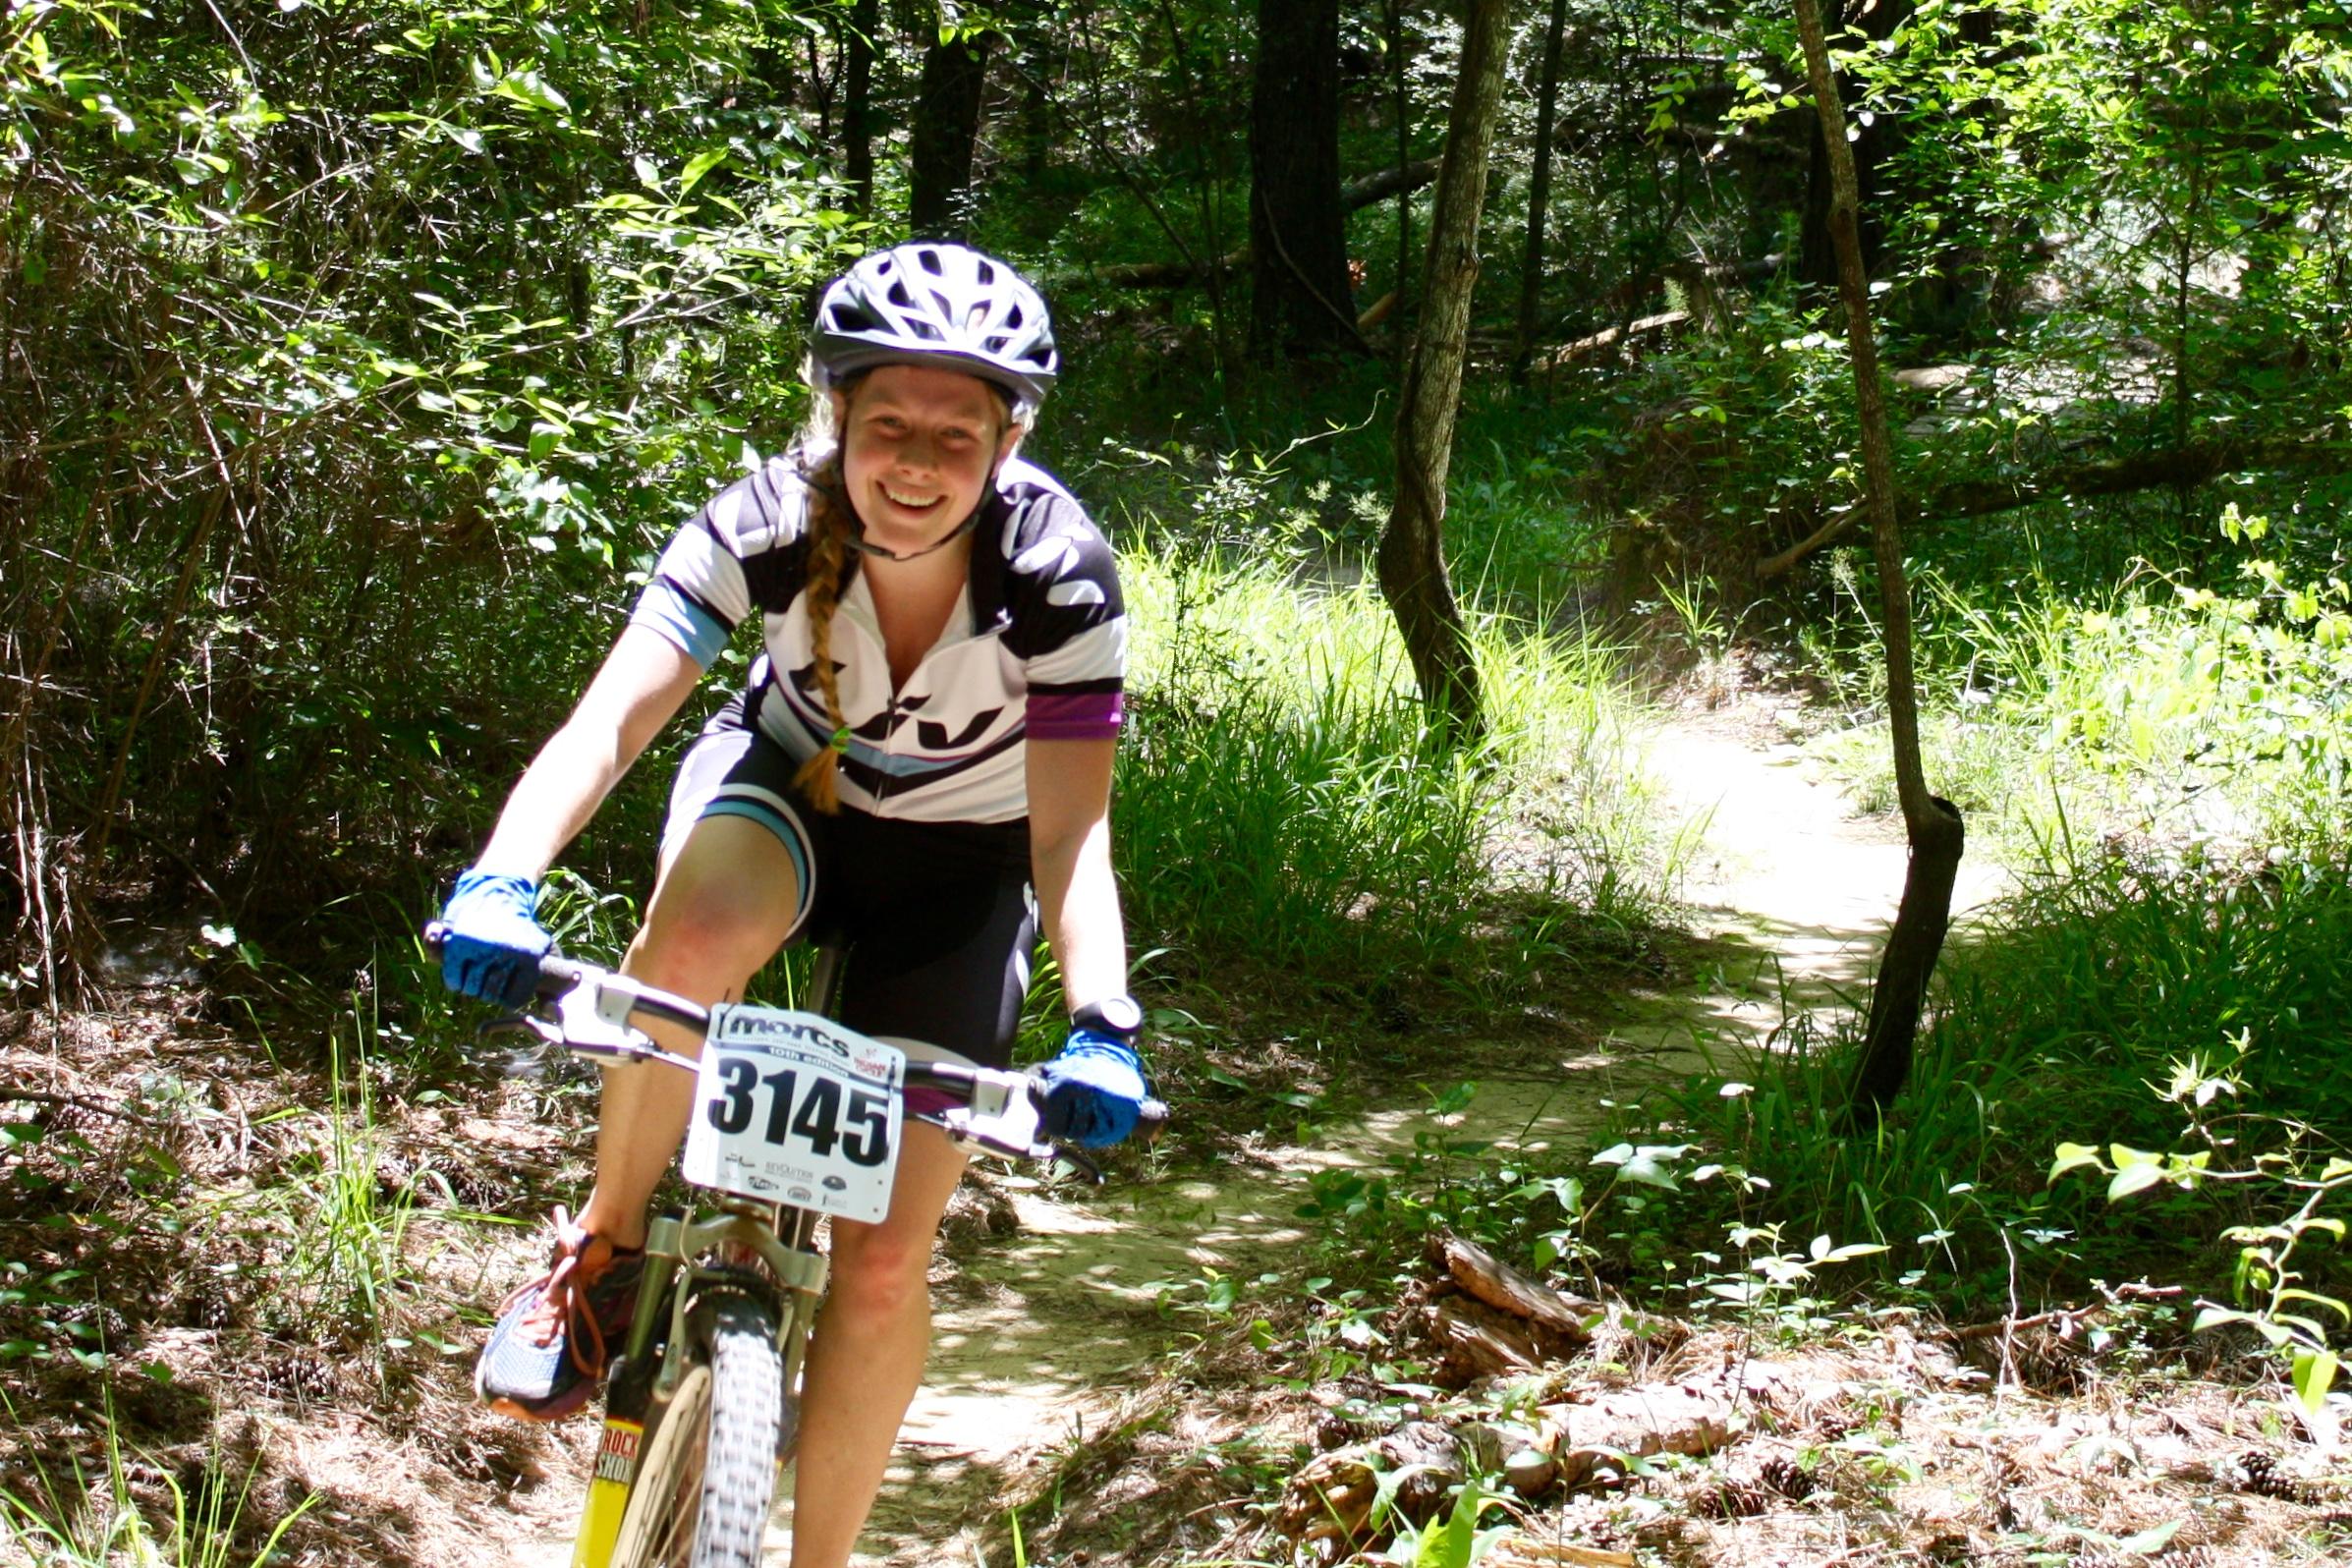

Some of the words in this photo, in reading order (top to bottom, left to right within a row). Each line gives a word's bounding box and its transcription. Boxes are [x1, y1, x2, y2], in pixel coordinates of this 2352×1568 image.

[768, 1046, 801, 1062] 10th
[803, 1055, 850, 1079] edition
[707, 1057, 889, 1167] 3145
[602, 1428, 639, 1458] ROCK
